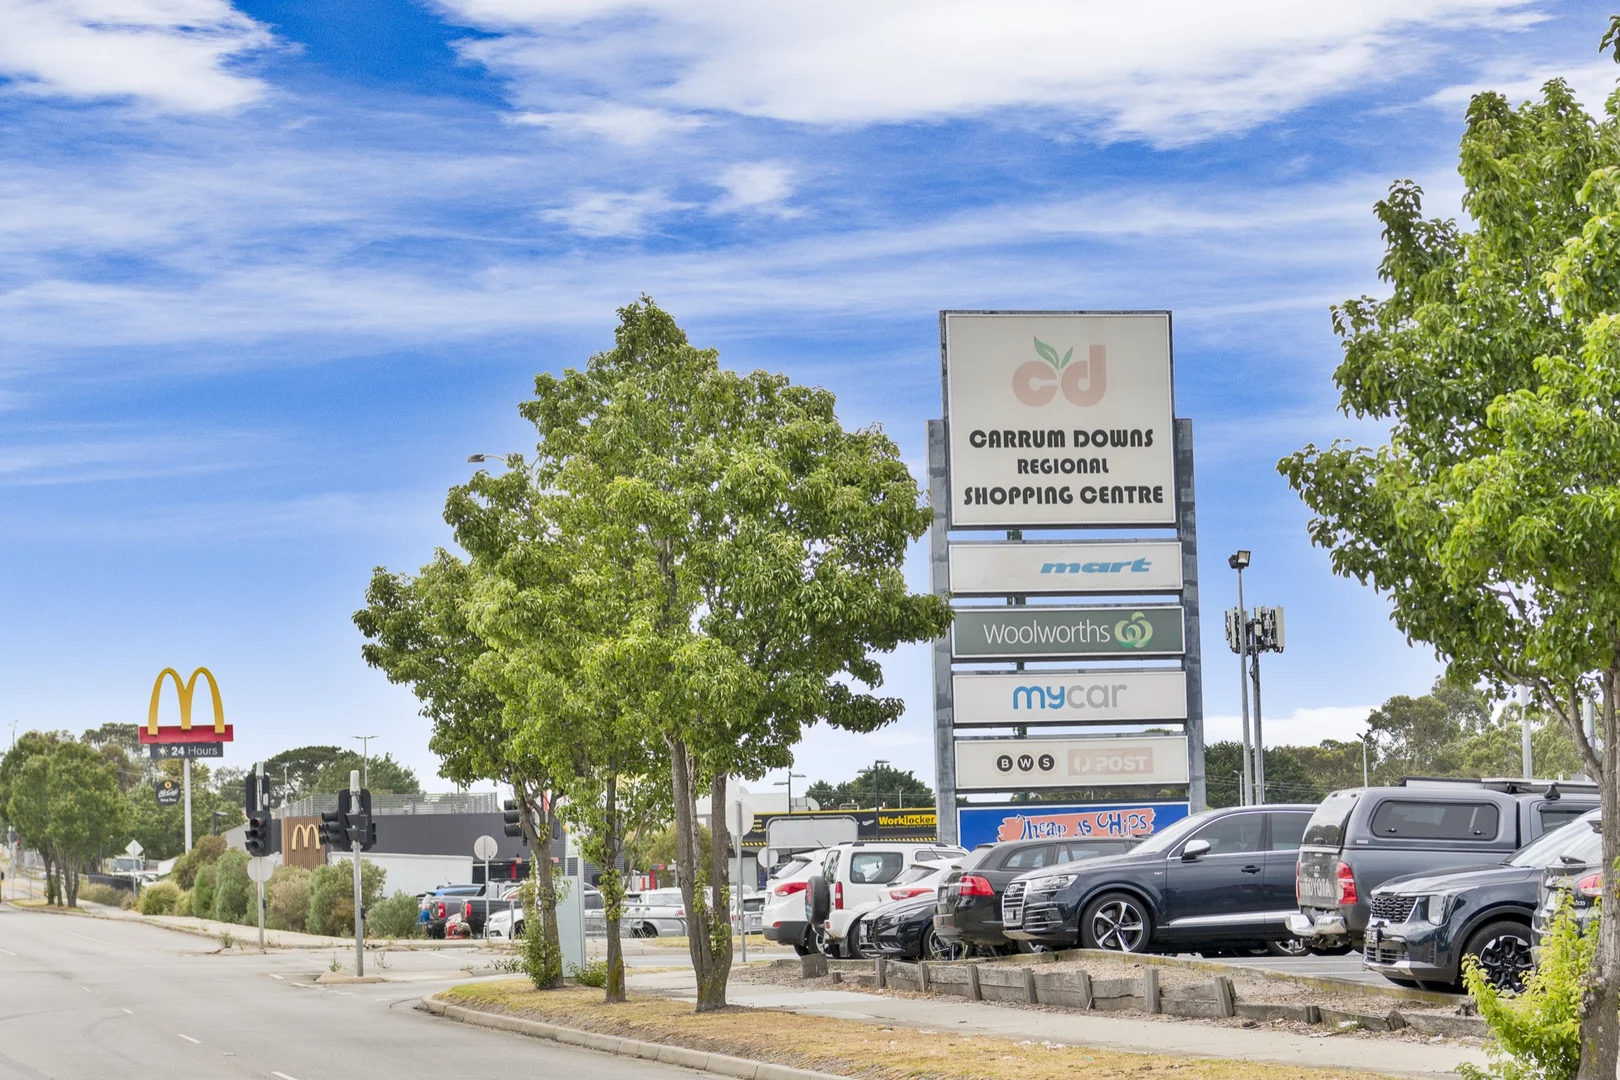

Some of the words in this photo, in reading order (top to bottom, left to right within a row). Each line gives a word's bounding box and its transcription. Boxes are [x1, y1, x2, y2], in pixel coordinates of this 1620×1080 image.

[969, 429, 1066, 448] CARRUM
[1073, 429, 1154, 448] DOWNS
[1017, 458, 1109, 474] REGIONAL
[964, 486, 1074, 505] SHOPPING
[1080, 485, 1164, 504] CENTRE
[1040, 557, 1152, 573] mart
[983, 619, 1111, 644] Woolworths
[1013, 684, 1128, 709] mycar
[171, 746, 185, 756] 24
[188, 746, 218, 755] Hours
[1096, 755, 1148, 772] POST
[878, 815, 936, 826] Worklocker
[1304, 878, 1332, 896] TOYOTA
